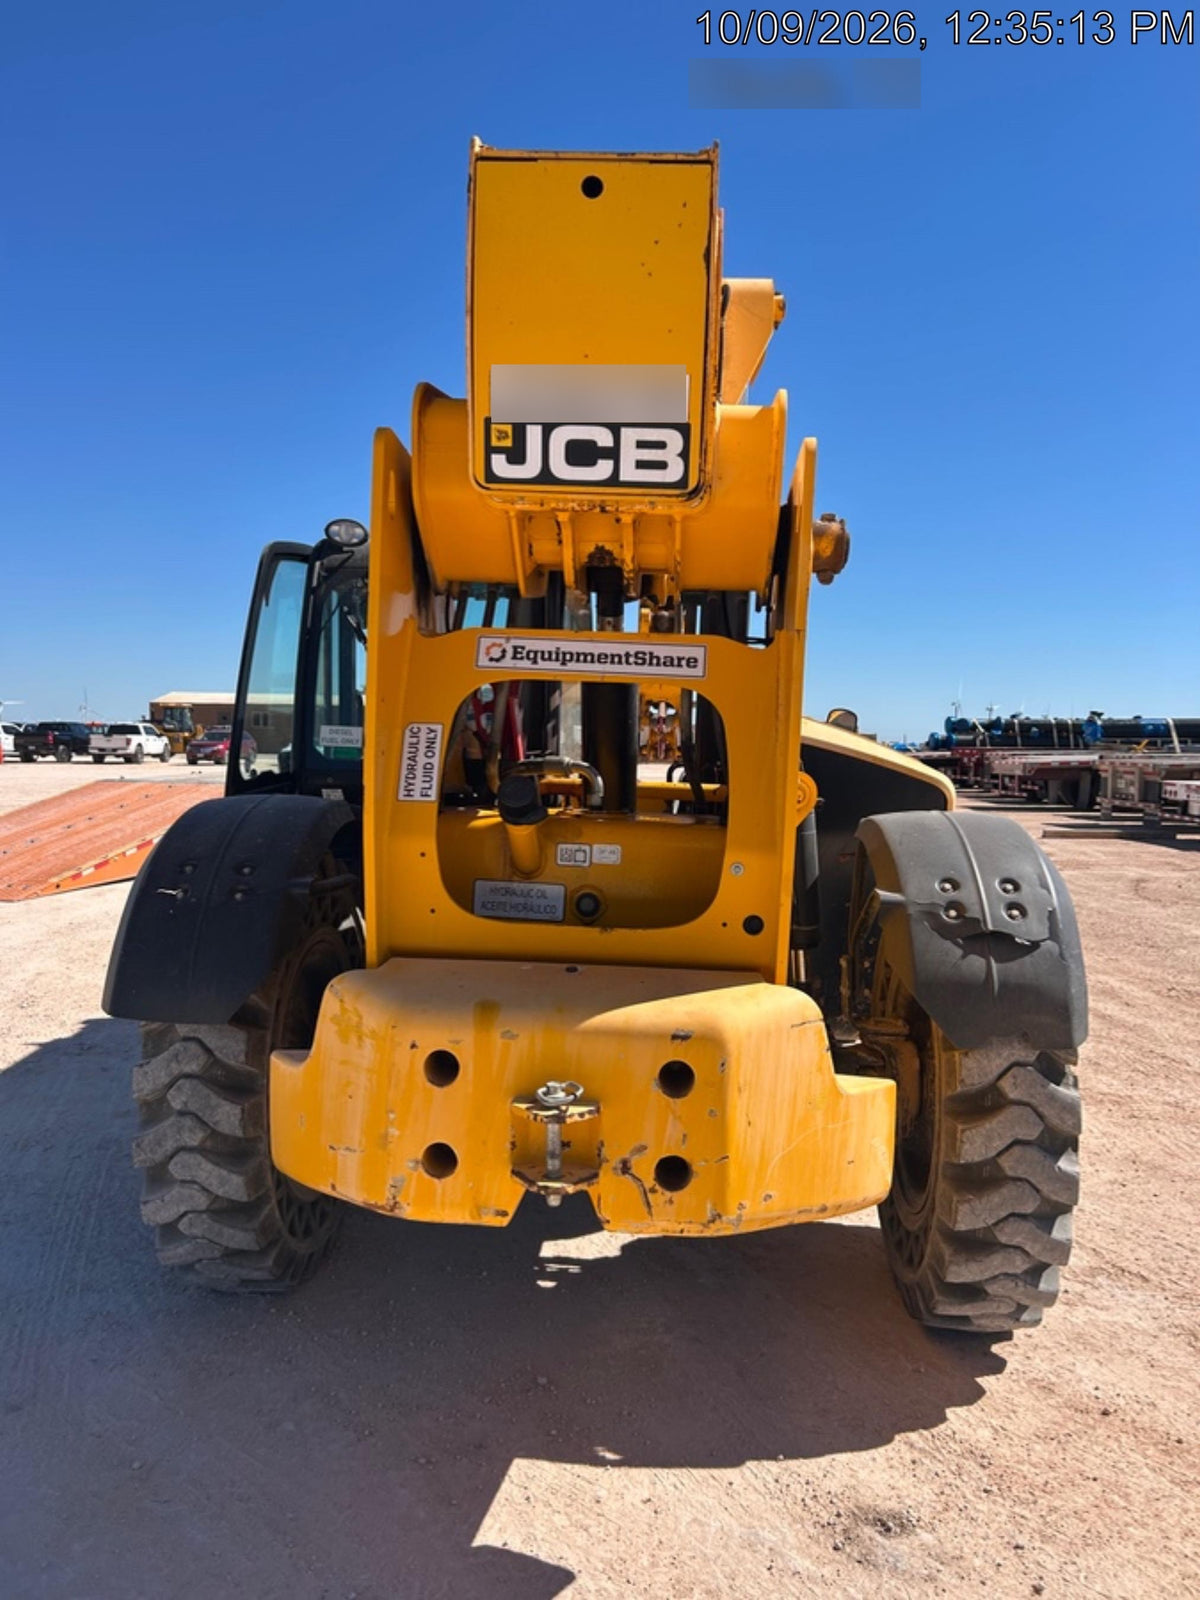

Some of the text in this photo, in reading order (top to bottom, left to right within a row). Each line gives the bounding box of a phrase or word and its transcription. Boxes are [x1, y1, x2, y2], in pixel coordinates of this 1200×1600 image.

[490, 424, 685, 483] JCB
[510, 645, 699, 669] EquipmentShare
[403, 726, 421, 798] HYDRAULIC
[420, 727, 438, 798] FLUID ONLY
